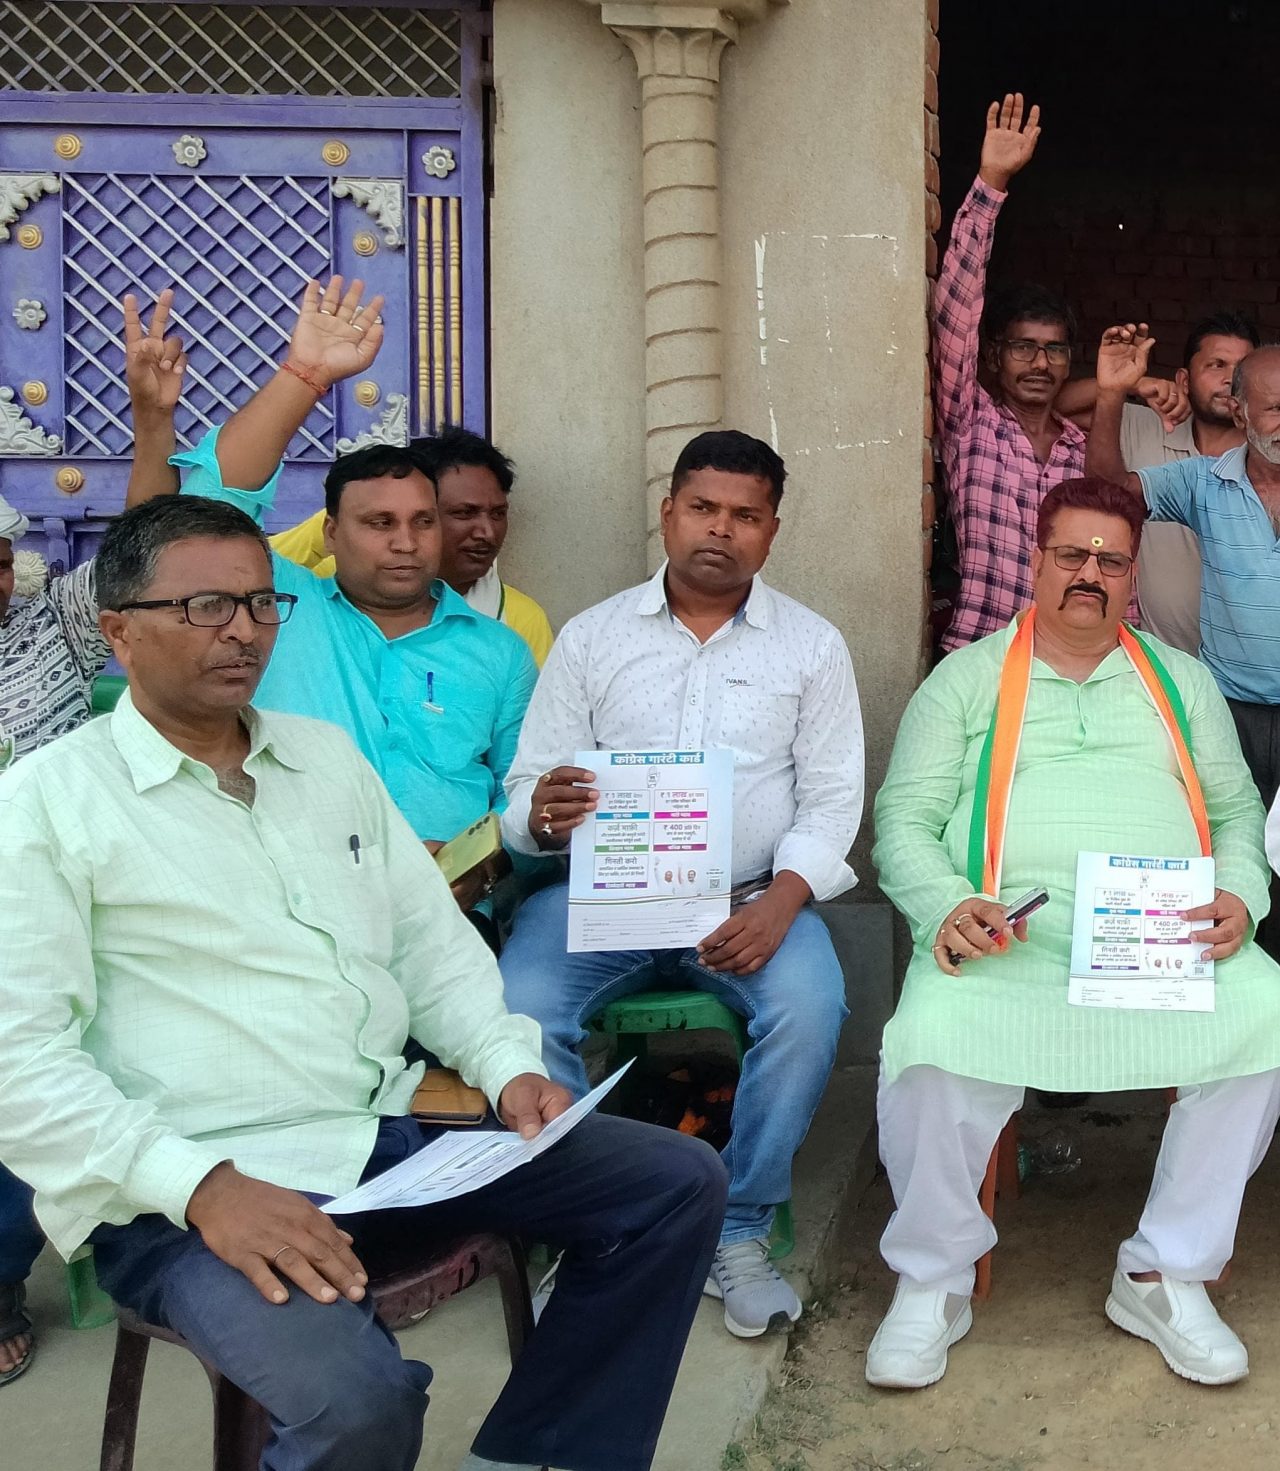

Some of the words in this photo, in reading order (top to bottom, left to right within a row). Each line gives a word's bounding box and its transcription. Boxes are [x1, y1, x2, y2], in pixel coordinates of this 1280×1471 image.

[614, 753, 646, 764] कांग्रेस
[648, 753, 677, 764] गारंटी
[679, 752, 702, 763] कार्ड
